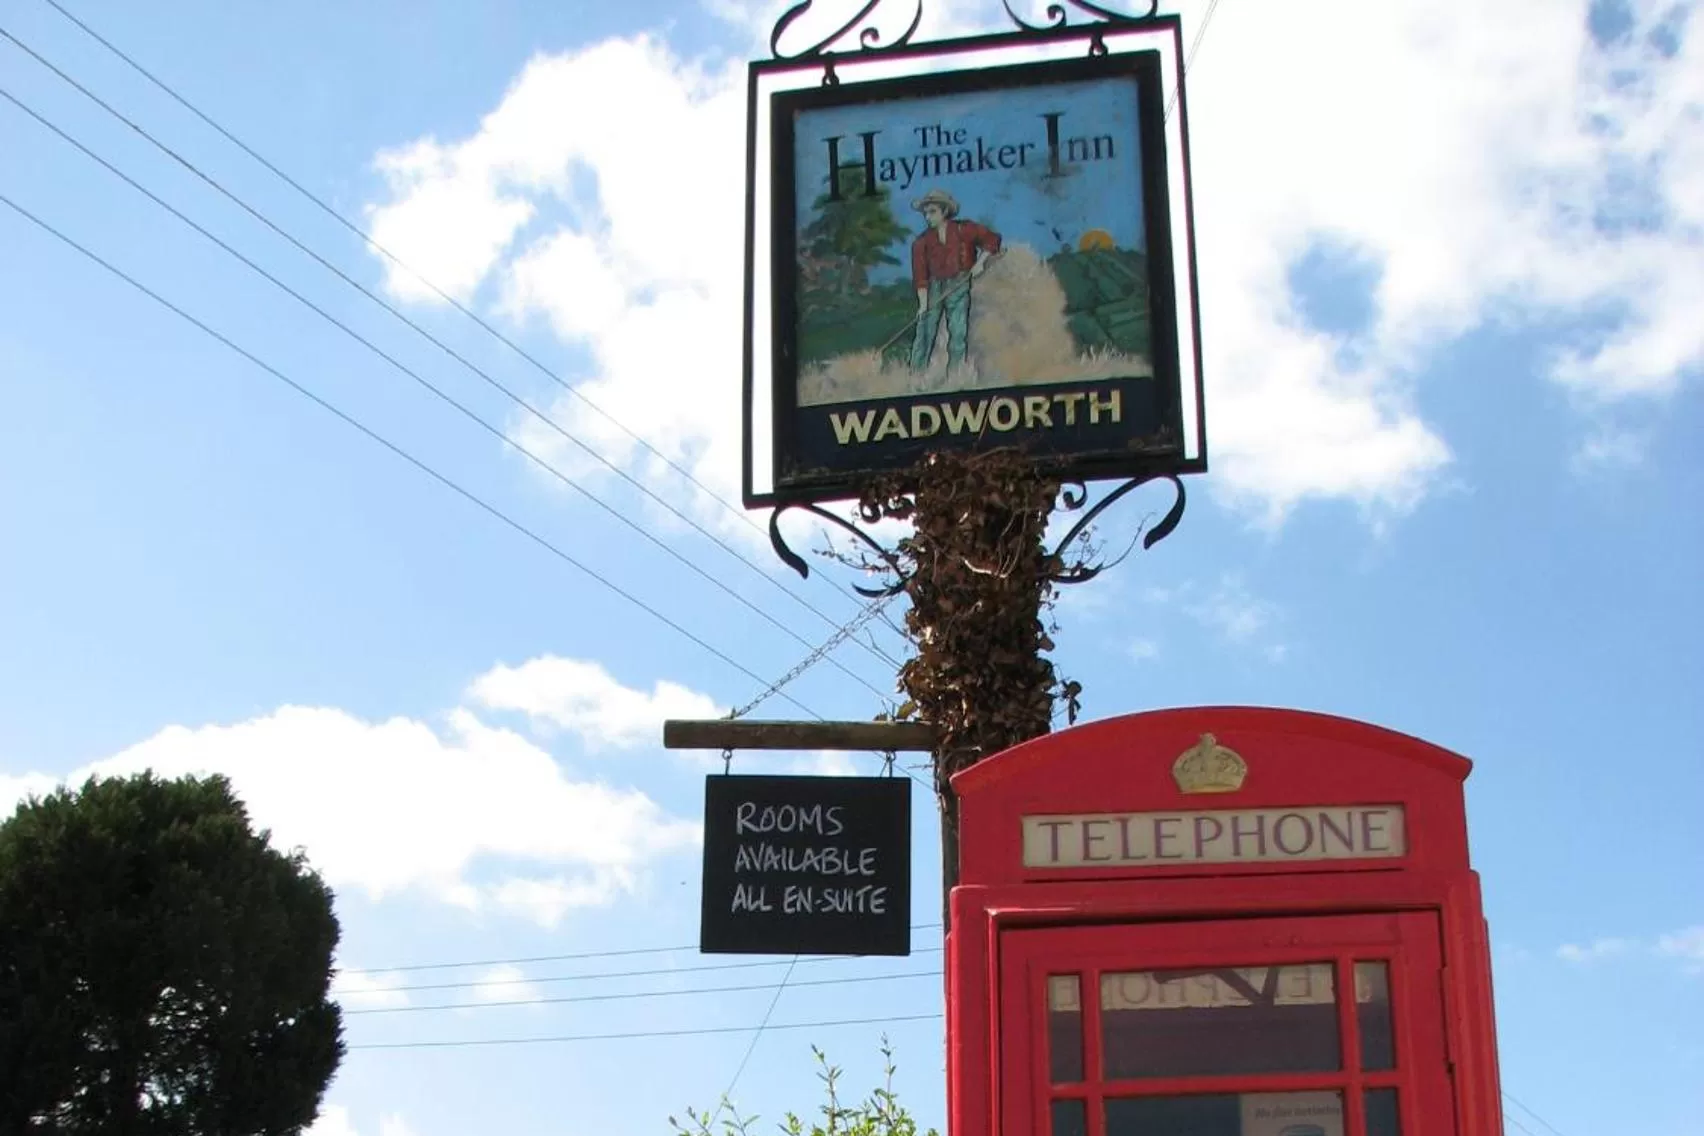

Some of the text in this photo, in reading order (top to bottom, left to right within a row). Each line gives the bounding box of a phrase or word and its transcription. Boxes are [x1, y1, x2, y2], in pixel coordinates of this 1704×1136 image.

[913, 123, 968, 147] The
[822, 111, 1116, 202] Haymaker Inn
[829, 389, 1122, 446] WADWORTH
[735, 802, 844, 836] ROOMS
[1037, 809, 1390, 863] TELEPHONE
[734, 843, 878, 876] AVAILABLE
[731, 883, 888, 914] ALL EN-SUITE
